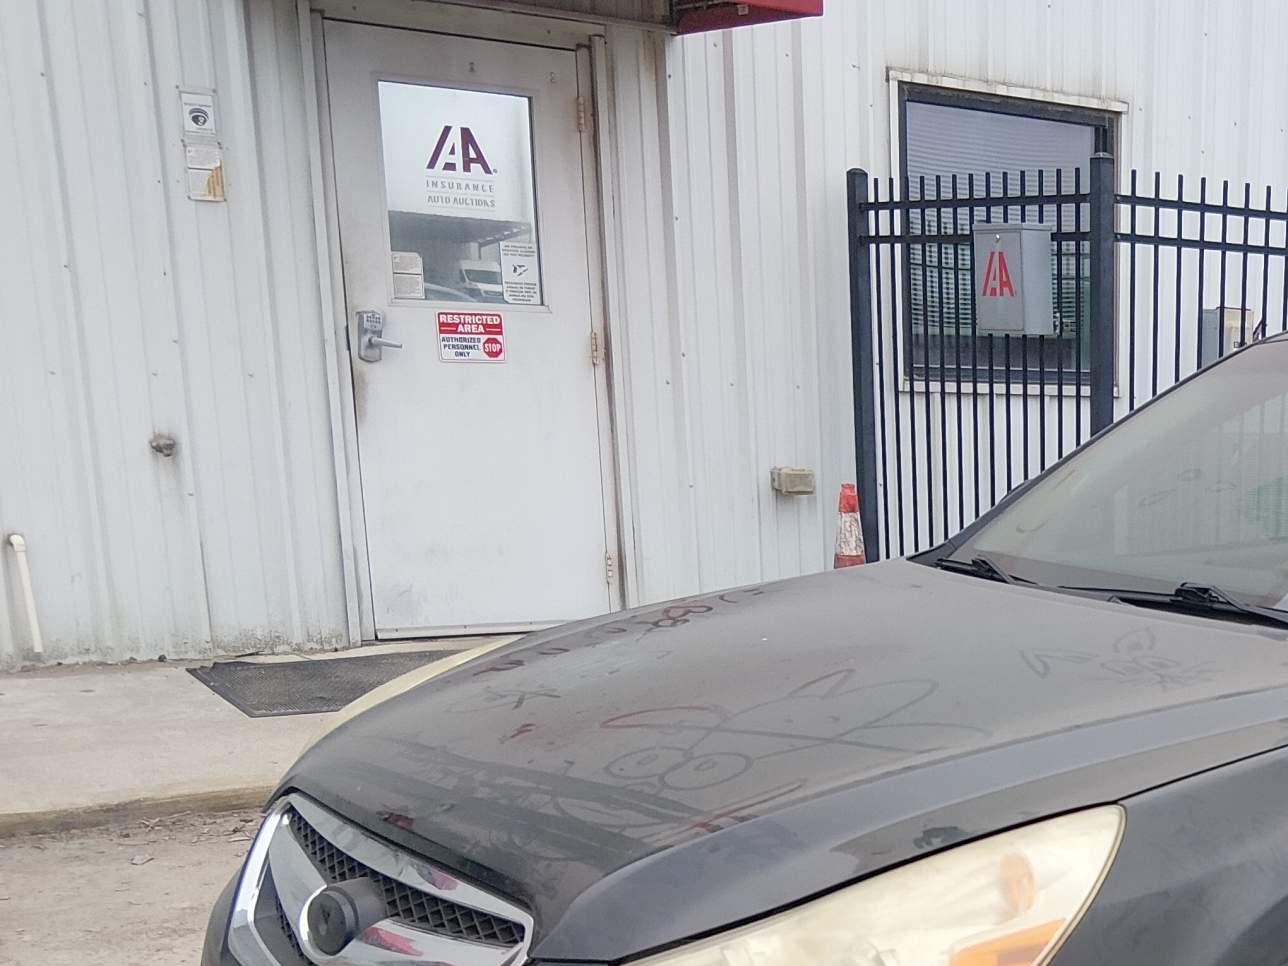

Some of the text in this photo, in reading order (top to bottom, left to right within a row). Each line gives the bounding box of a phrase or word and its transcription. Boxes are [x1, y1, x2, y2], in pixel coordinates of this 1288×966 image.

[426, 180, 495, 192] INSURANCE
[428, 195, 496, 208] AUTO AUCTIONS
[440, 314, 501, 324] RESTRICTED
[457, 324, 485, 333] AREA
[442, 336, 482, 344] AUTHORIZED
[444, 343, 480, 351] PERSONNEL
[485, 343, 501, 352] STOP
